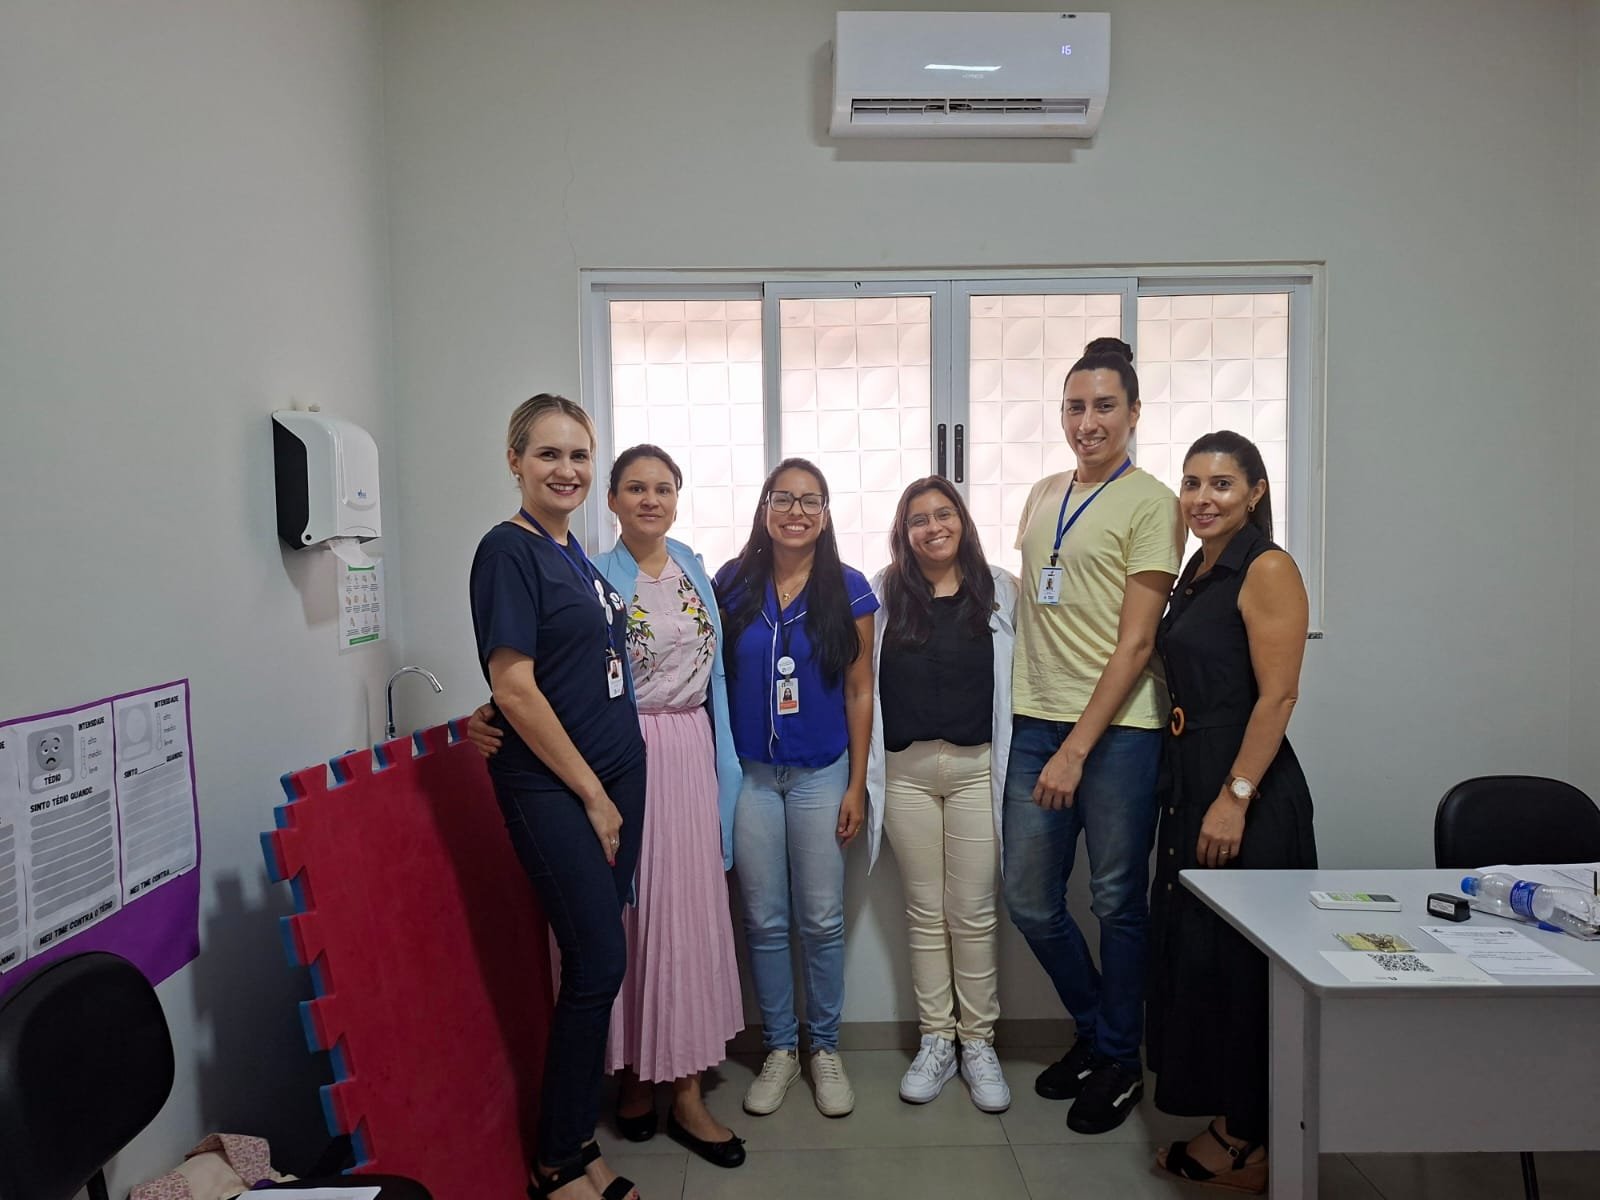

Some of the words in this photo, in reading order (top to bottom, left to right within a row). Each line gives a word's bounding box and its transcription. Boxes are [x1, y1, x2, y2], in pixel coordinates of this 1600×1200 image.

[1062, 45, 1072, 55] 16
[44, 773, 61, 785] TÉDIO
[123, 768, 138, 778] SINTO
[30, 800, 50, 813] SINTO
[52, 794, 69, 806] TÉDIO
[70, 786, 93, 800] QUANDO
[152, 869, 170, 883] CONTRA
[39, 932, 53, 946] MEU
[54, 924, 68, 938] TIME
[69, 911, 94, 930] CONTRA
[94, 909, 99, 918] O
[99, 900, 113, 914] TÉDIO
